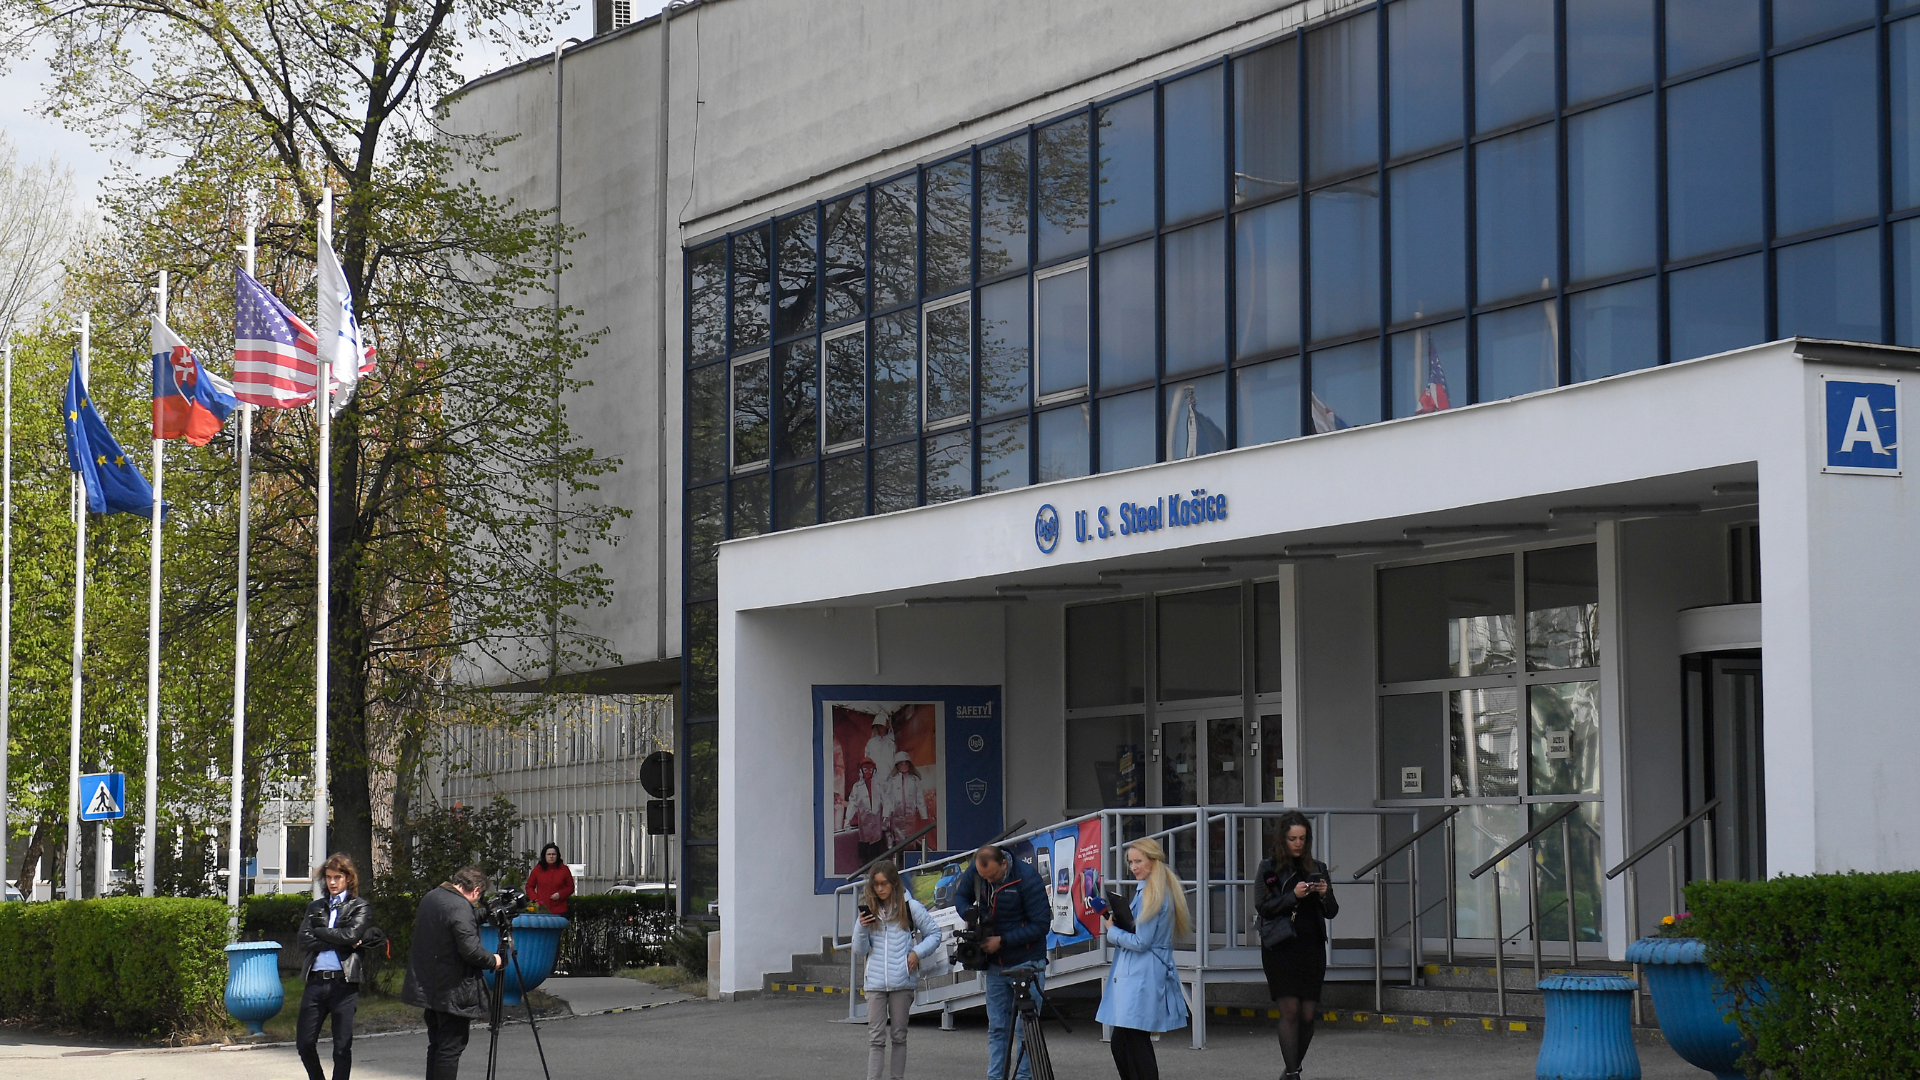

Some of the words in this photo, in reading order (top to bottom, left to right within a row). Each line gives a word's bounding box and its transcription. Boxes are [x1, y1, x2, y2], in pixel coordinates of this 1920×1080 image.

[1840, 396, 1884, 454] A
[1074, 509, 1093, 543] U.
[1097, 505, 1115, 540] S.
[1119, 496, 1164, 536] Steel
[1168, 488, 1228, 528] Košice
